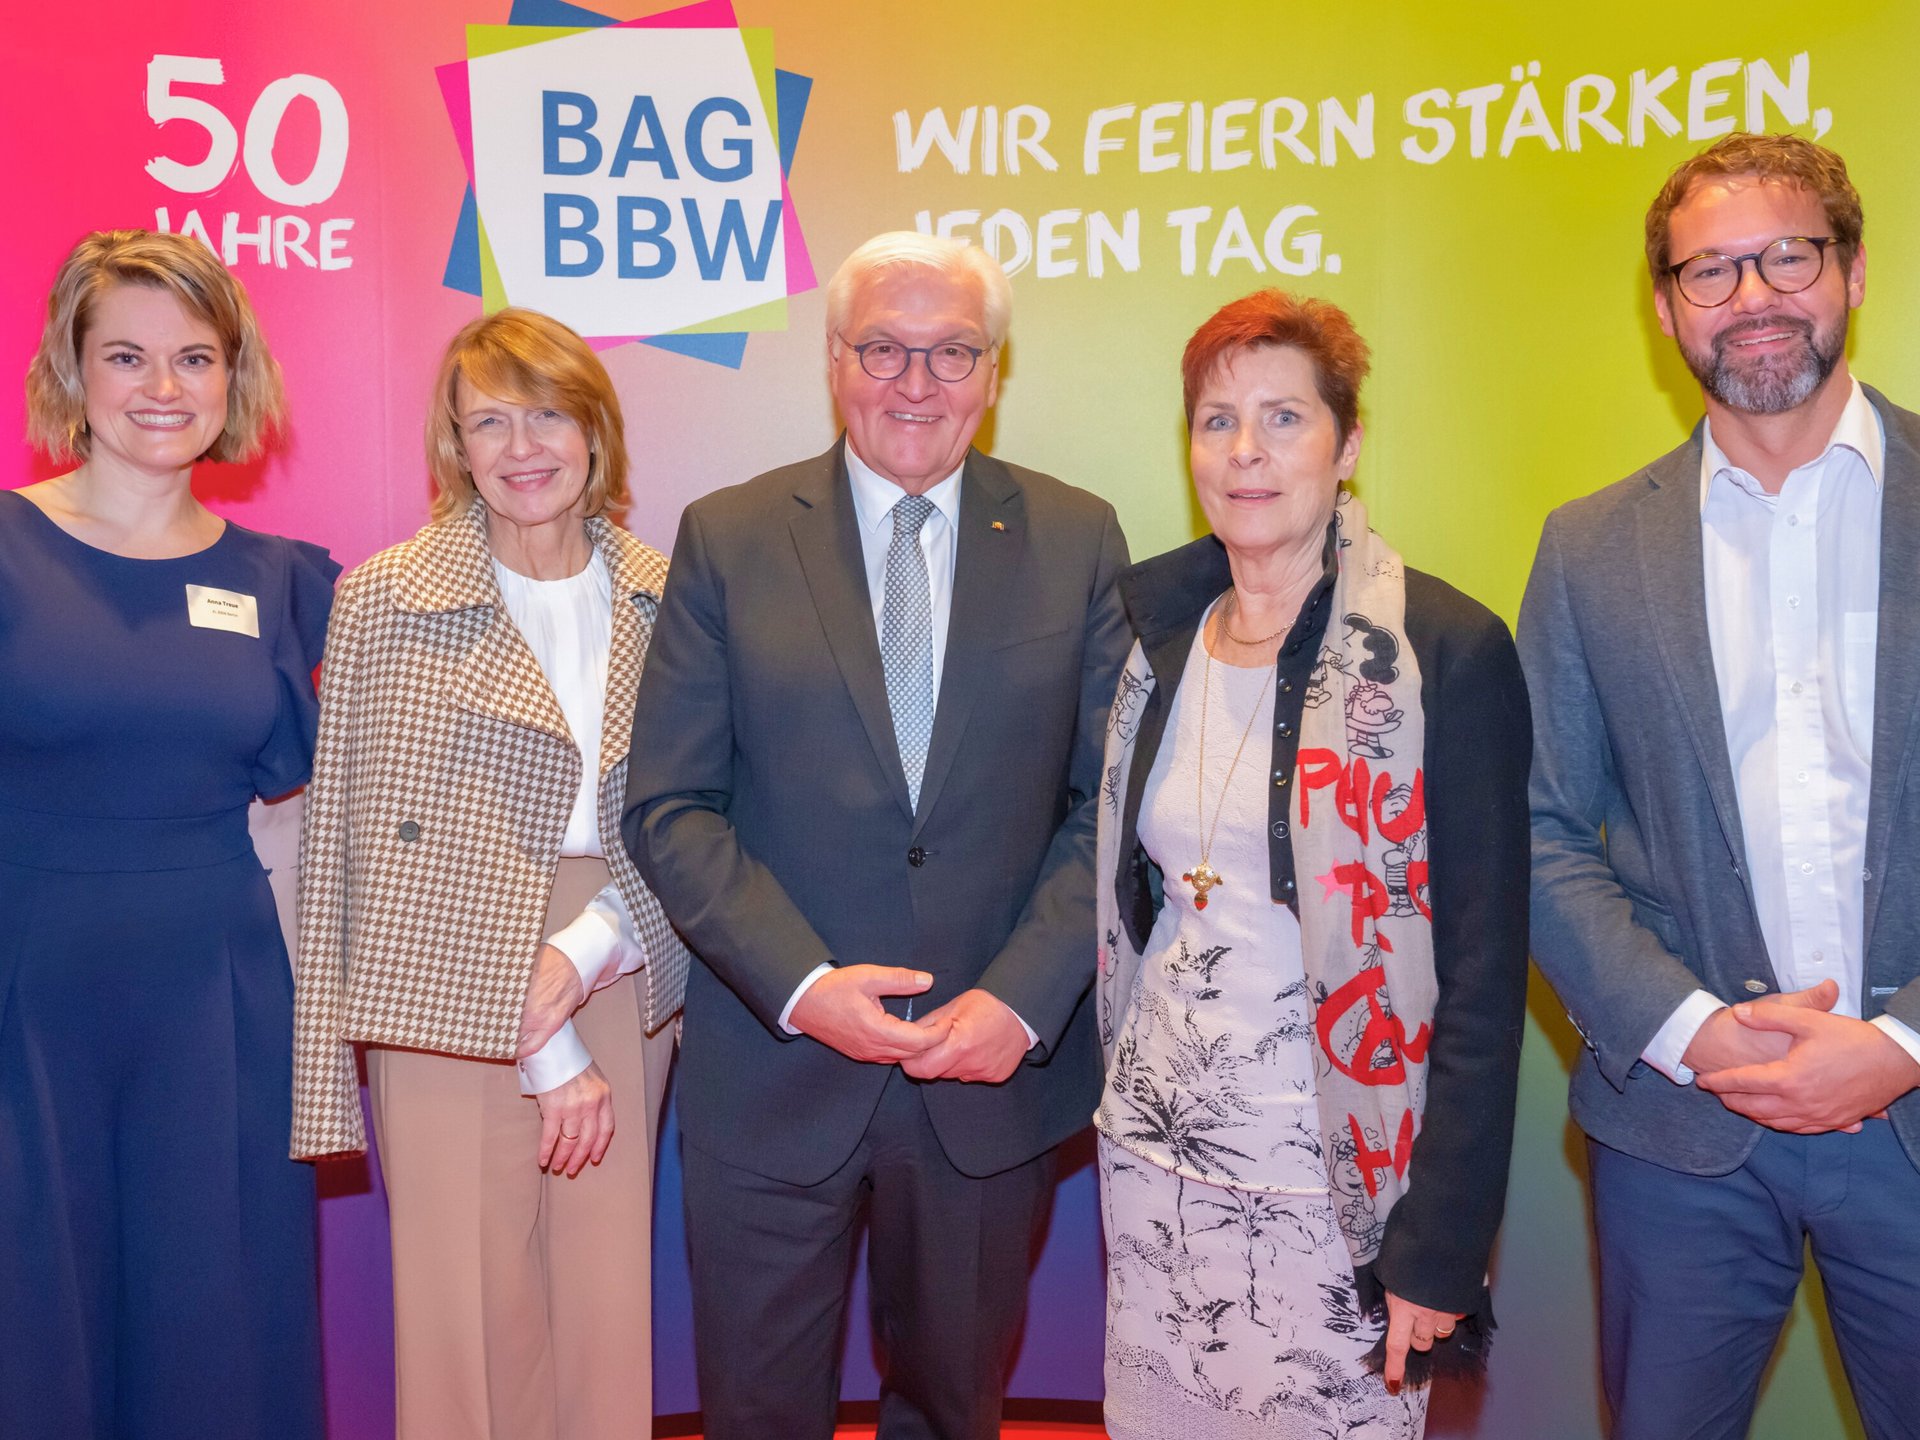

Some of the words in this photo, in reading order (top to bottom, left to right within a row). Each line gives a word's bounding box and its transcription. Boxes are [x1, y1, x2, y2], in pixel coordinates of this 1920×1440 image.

[143, 54, 350, 208] 50
[541, 91, 755, 183] BAG
[892, 105, 1059, 176] WIR
[1083, 91, 1376, 176] FEIERN
[1400, 50, 1834, 165] STÄRKEN,
[543, 193, 784, 282] BBW
[1165, 204, 1343, 278] TAG.
